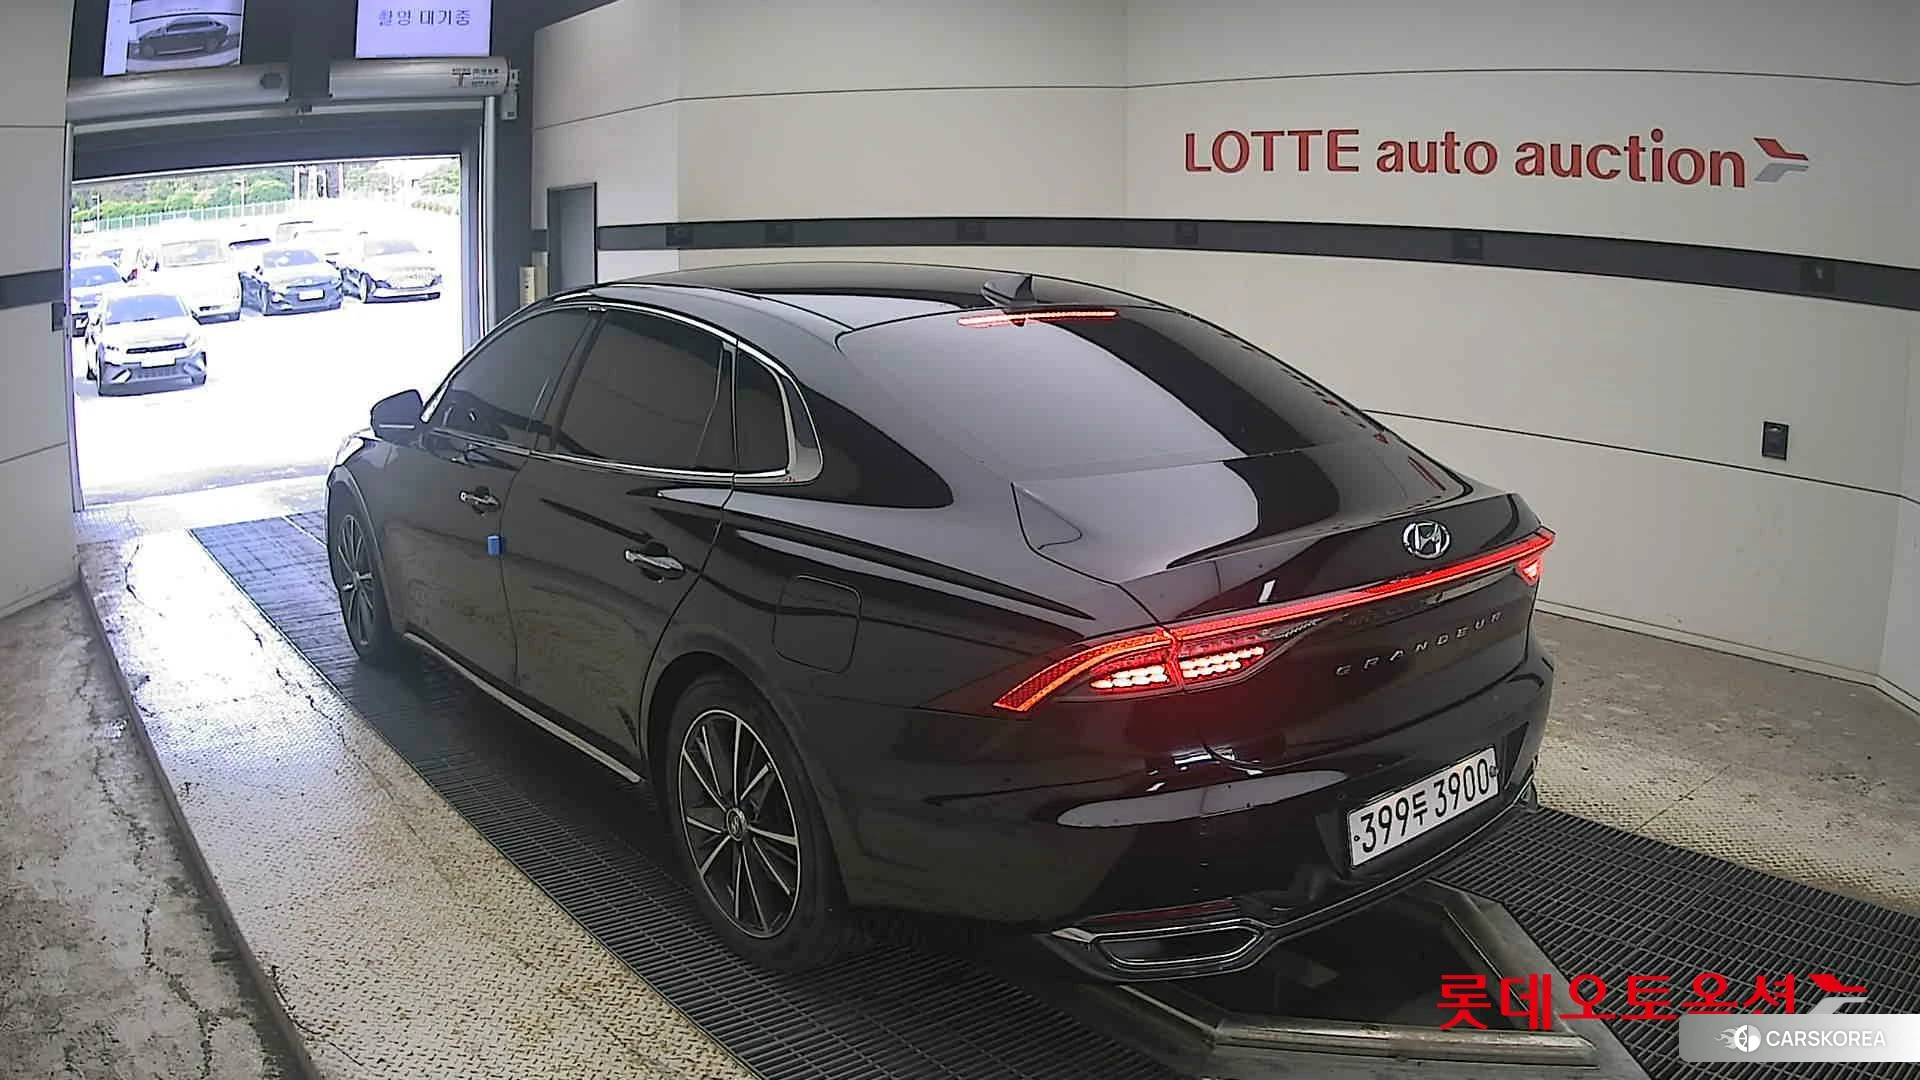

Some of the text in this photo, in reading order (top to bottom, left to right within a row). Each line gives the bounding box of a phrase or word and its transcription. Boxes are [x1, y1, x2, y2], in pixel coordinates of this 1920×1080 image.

[419, 9, 471, 26] 대기중
[1185, 128, 1746, 188] LOTTE auto auction
[1335, 611, 1502, 677] GRANDEUR
[1360, 758, 1490, 853] 399두 3900
